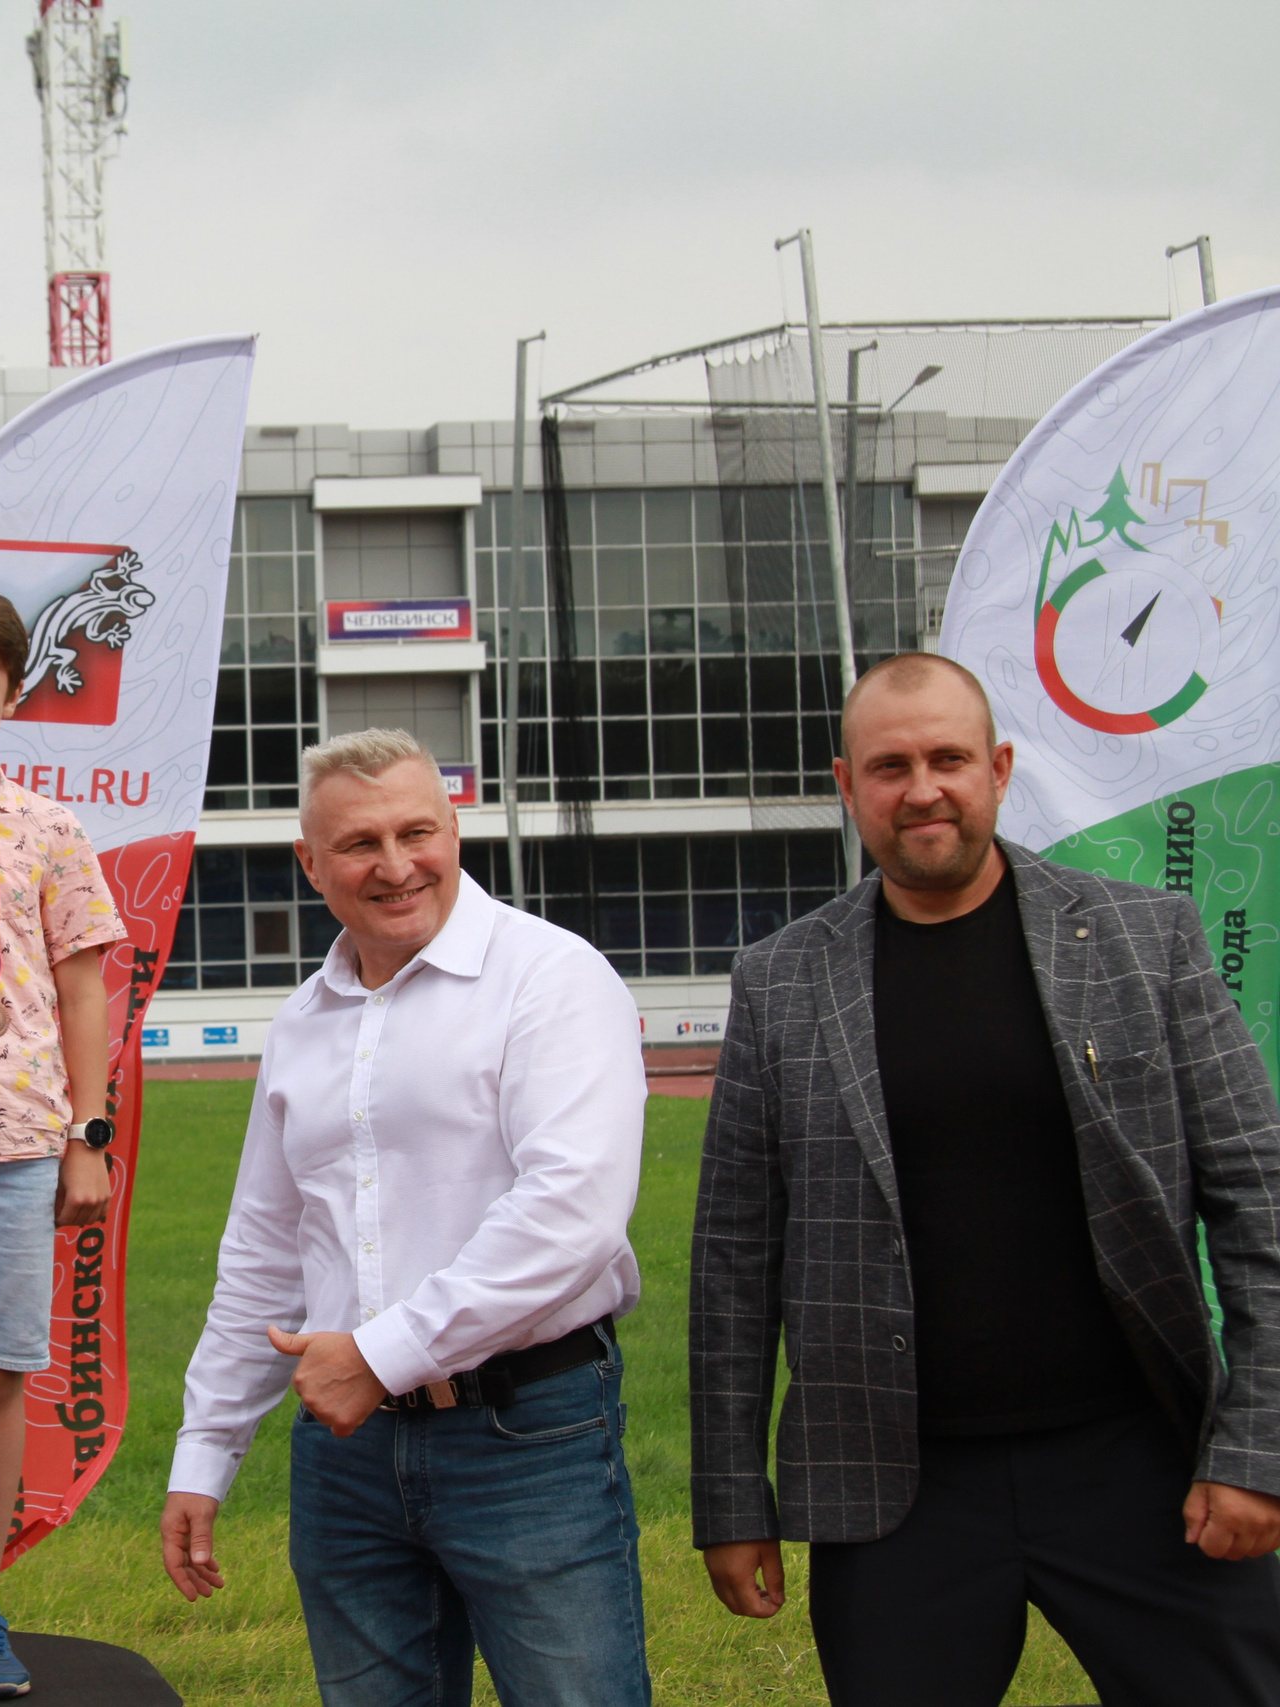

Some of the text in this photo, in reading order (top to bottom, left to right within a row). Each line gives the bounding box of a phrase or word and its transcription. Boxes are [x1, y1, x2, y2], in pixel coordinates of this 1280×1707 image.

[347, 612, 456, 627] ЧЕЛЯБИНСК
[2, 763, 150, 807] HEL.RU
[694, 1022, 720, 1033] ПСБ
[55, 1217, 106, 1483] ябинско
